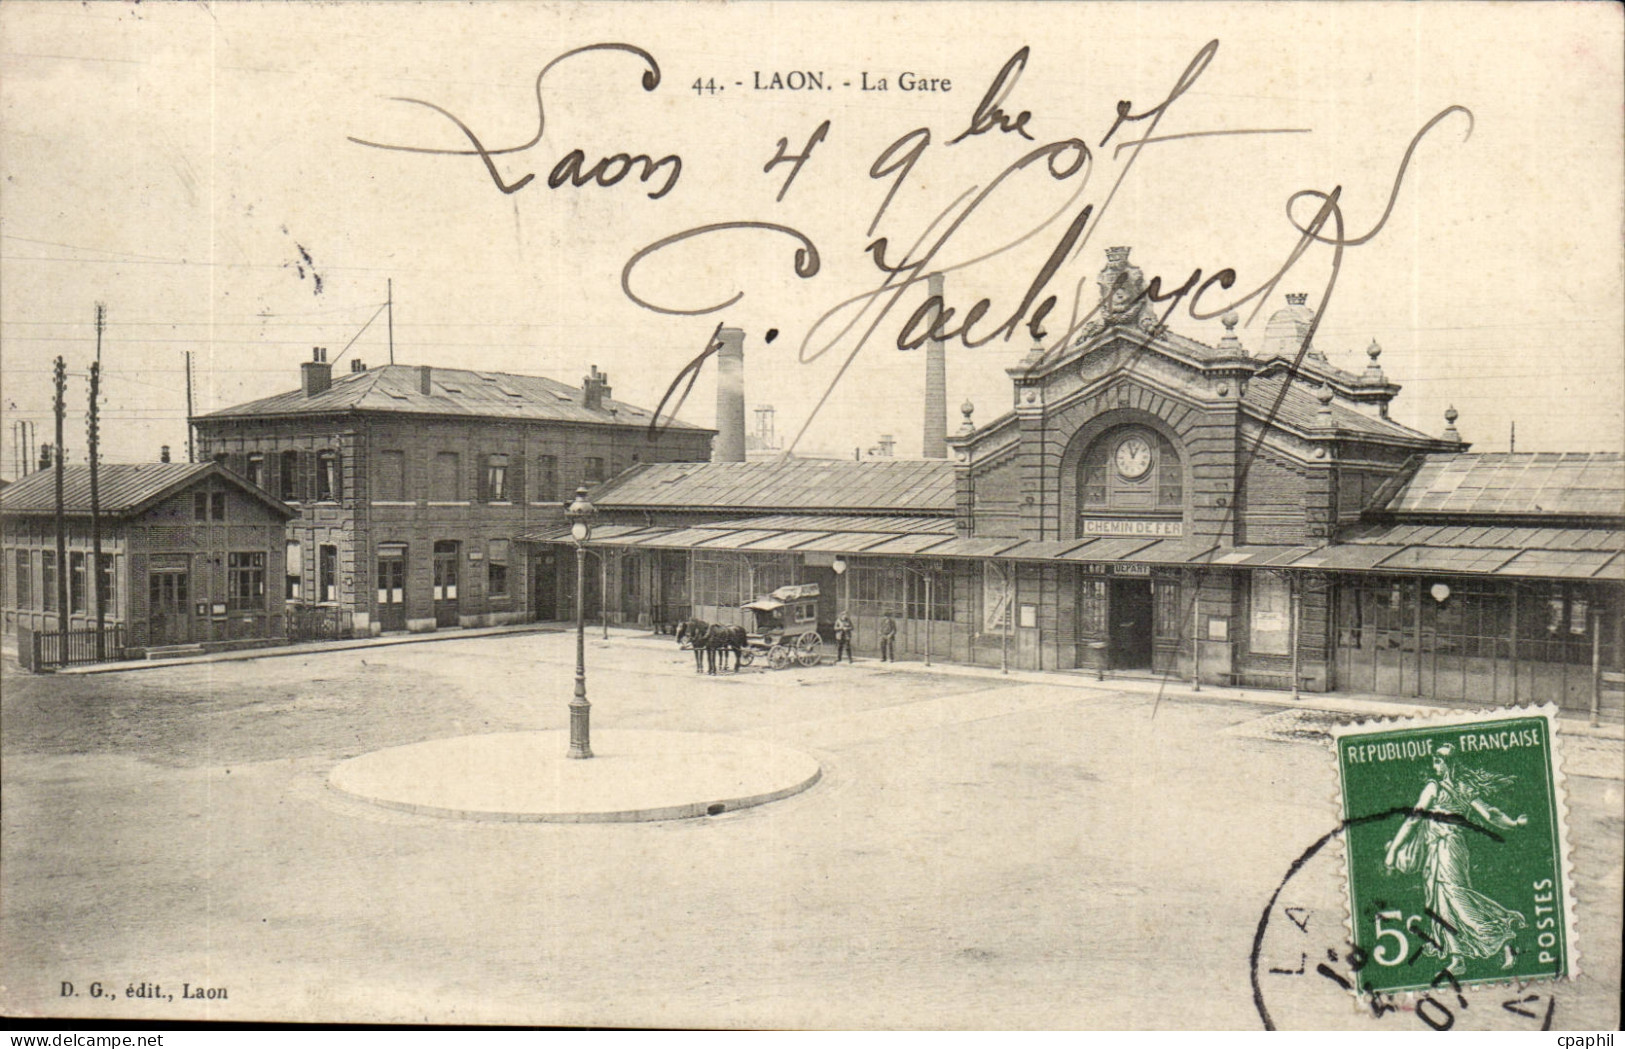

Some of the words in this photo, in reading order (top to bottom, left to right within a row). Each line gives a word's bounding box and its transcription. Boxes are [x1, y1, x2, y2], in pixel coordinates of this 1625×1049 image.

[691, 77, 725, 95] 44.
[754, 71, 832, 91] LAON.
[861, 72, 888, 91] La
[898, 72, 952, 91] Gare
[348, 42, 682, 200] Laon
[763, 120, 831, 202] 4
[1086, 521, 1133, 533] CHEMIN
[1136, 522, 1153, 533] DE
[1156, 523, 1181, 534] FER
[1459, 728, 1541, 753] FRANÇAISE
[1533, 878, 1556, 964] POSTES
[60, 981, 79, 998] D.
[125, 983, 173, 1002] édit.,
[182, 983, 228, 1000] Laon
